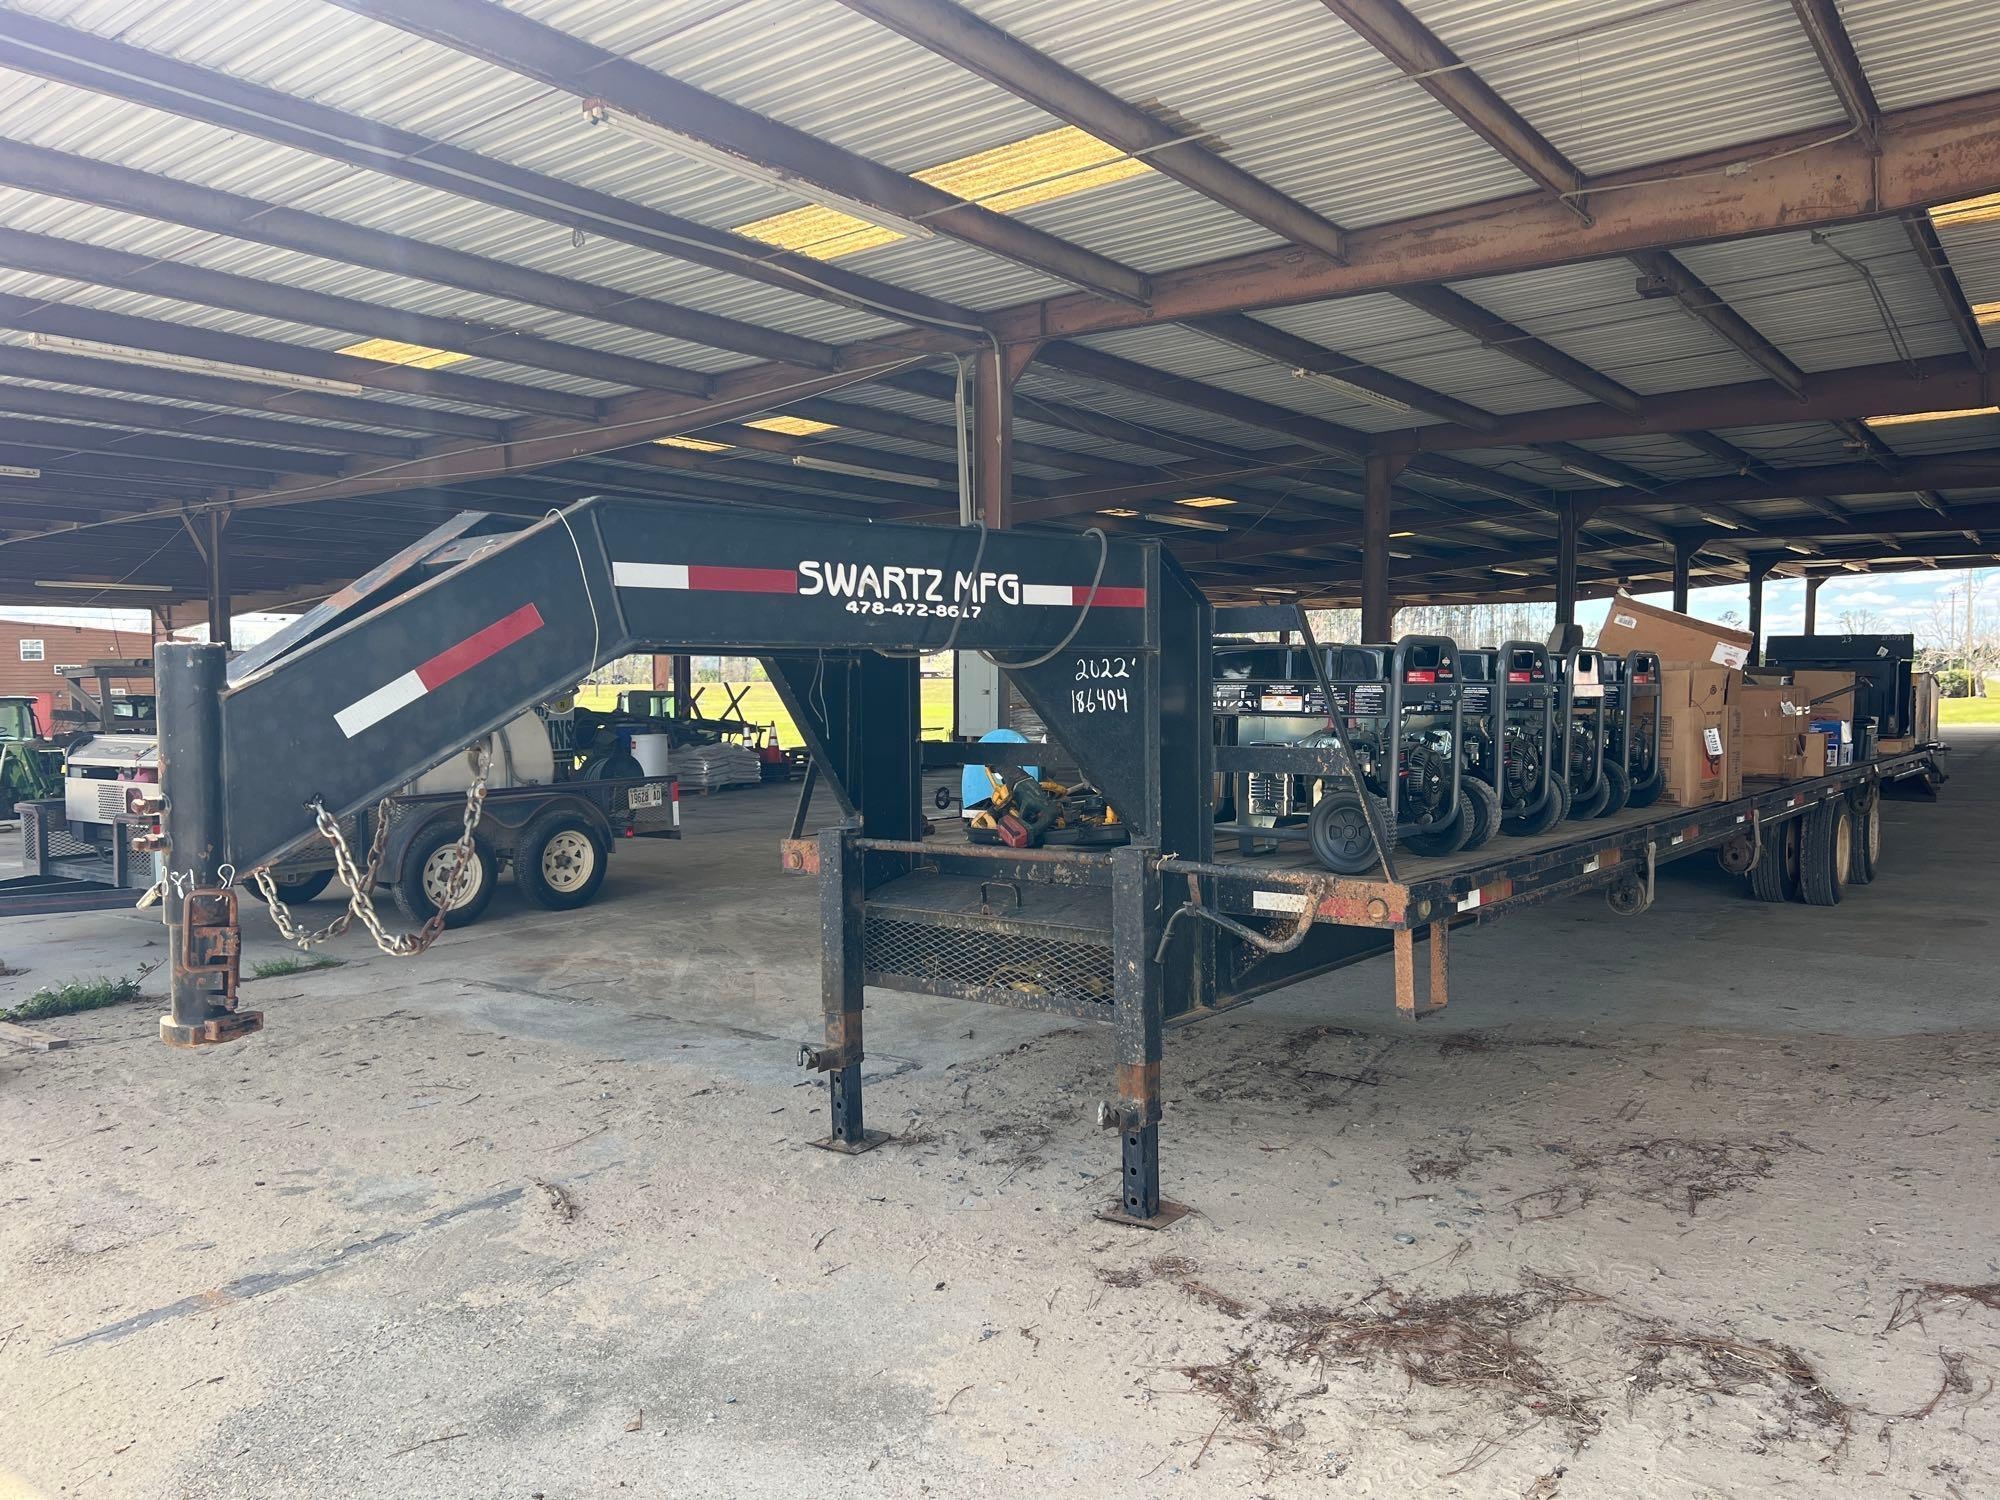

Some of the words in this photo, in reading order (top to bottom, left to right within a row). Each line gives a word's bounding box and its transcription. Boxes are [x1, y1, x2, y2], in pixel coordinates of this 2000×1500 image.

[799, 560, 943, 601] SWARTZ
[954, 570, 1020, 606] MFG
[1071, 688, 1128, 714] 186404
